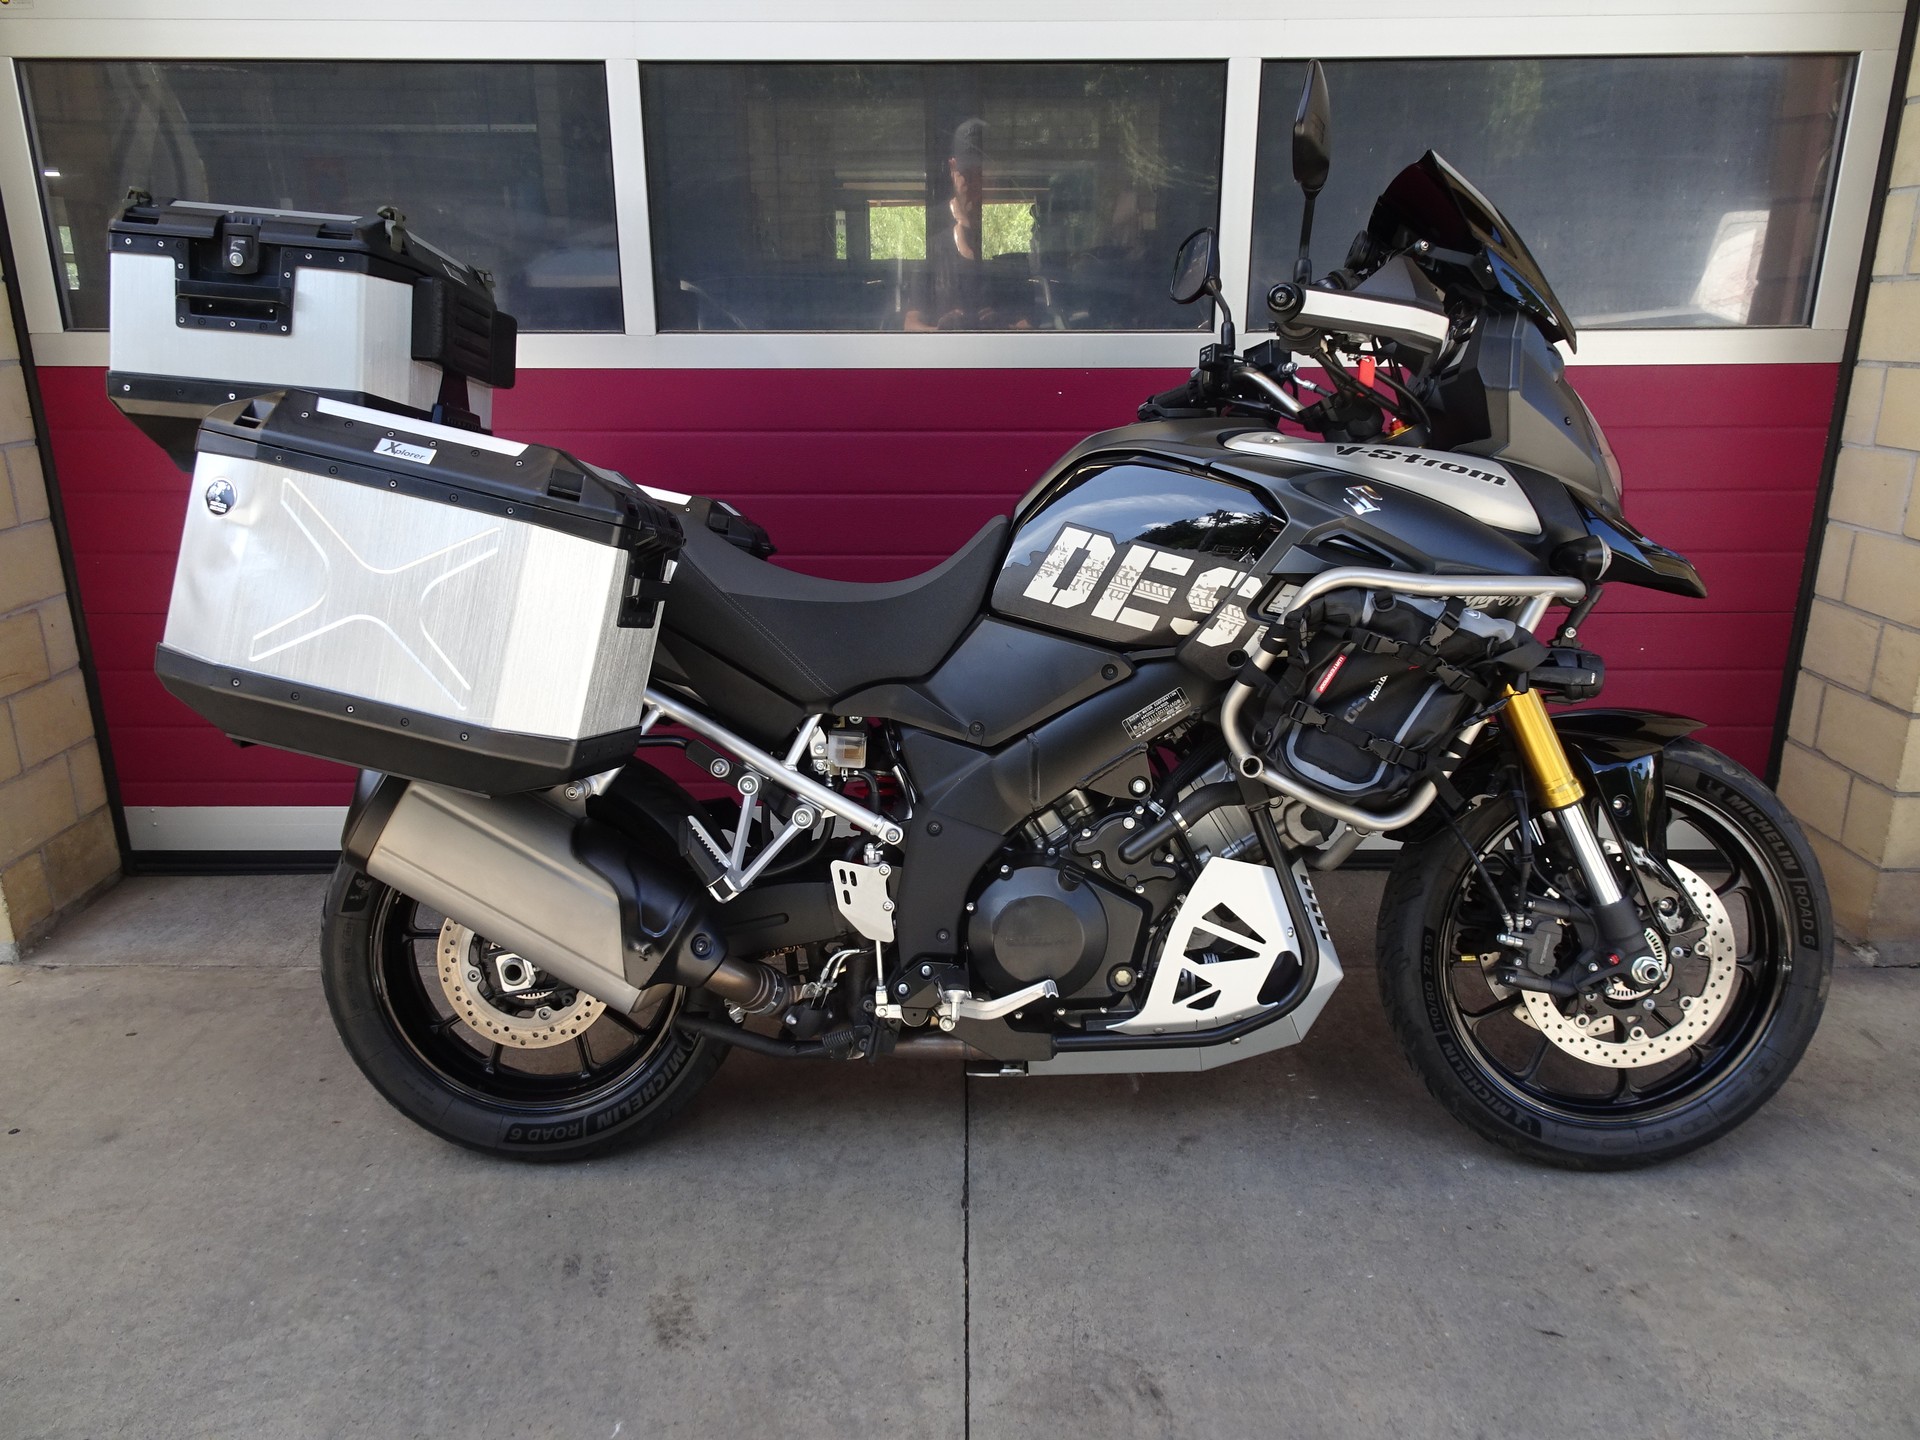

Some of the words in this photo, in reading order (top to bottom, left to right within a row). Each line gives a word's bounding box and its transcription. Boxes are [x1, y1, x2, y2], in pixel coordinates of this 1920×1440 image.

[382, 441, 426, 460] Xplorer
[1336, 445, 1507, 487] V-Strom
[1728, 795, 1798, 870] MICHELIN
[1794, 884, 1816, 931] ROAD
[1424, 934, 1434, 951] 19
[1802, 935, 1816, 947] 6
[1423, 955, 1433, 976] ZR
[1425, 981, 1443, 1031] 110/80
[596, 1046, 687, 1129] MICHELIN
[1443, 1042, 1513, 1117] MICHELIN
[509, 1126, 523, 1140] 6
[527, 1121, 581, 1141] ROAD
